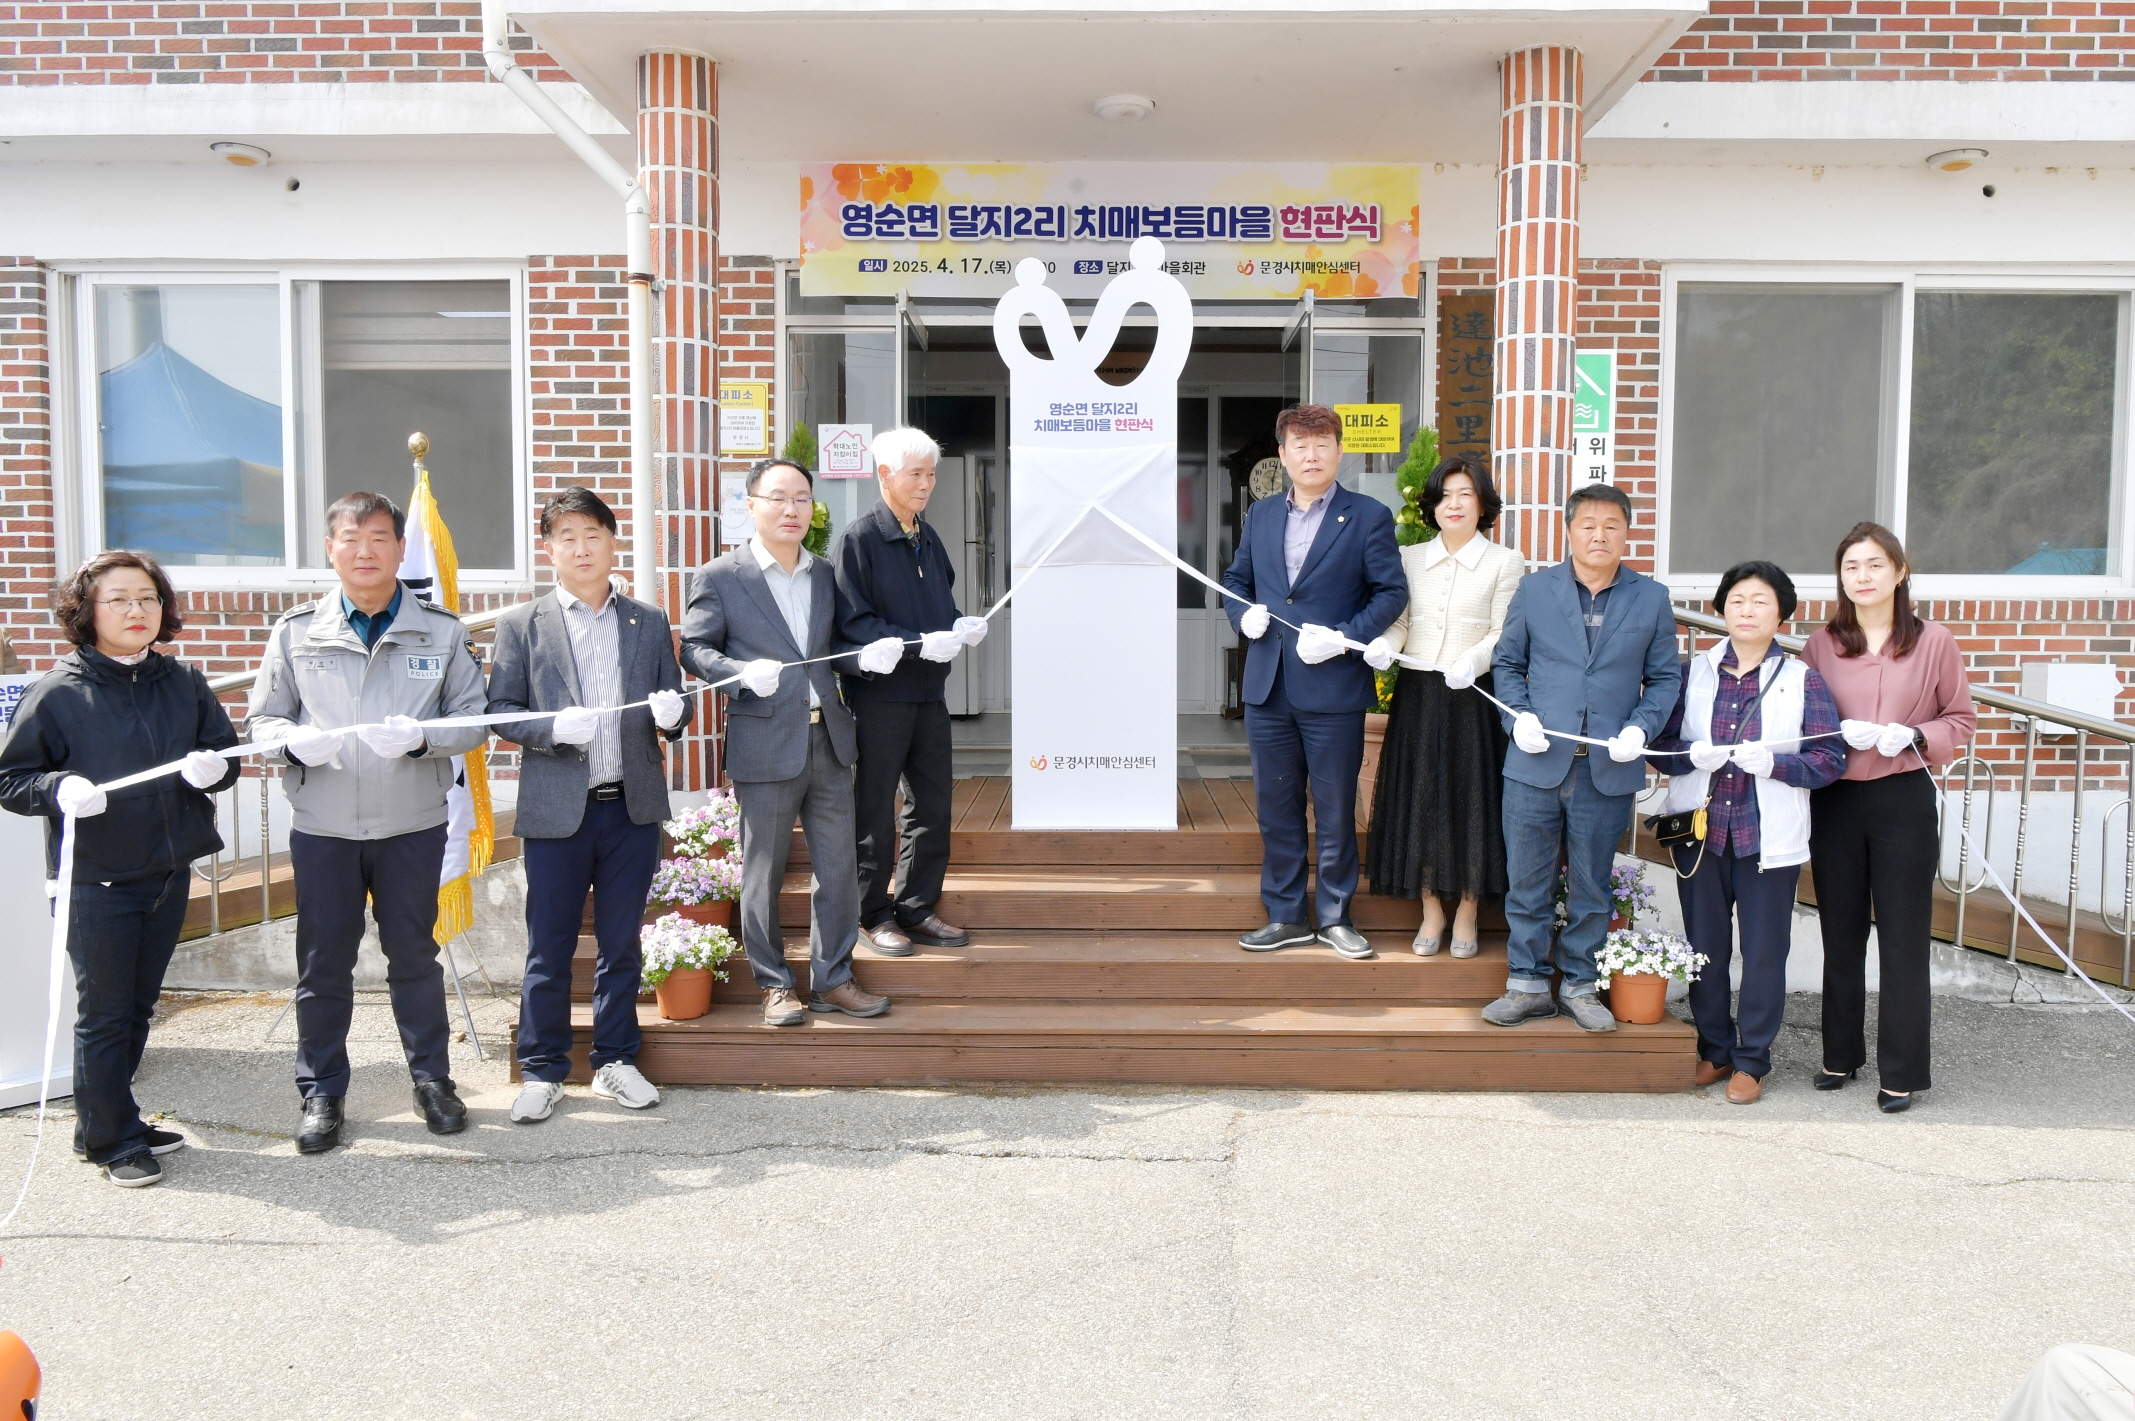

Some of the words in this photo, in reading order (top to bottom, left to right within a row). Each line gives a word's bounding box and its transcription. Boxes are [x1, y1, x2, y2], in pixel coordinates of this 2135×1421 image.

[842, 203, 939, 238] 영순면
[949, 204, 1065, 239] 달지2리
[1073, 205, 1272, 239] 치매보듬마을
[1279, 205, 1378, 239] 현판식
[863, 260, 884, 272] 일시
[892, 260, 933, 274] 2025.
[936, 258, 954, 274] 4.
[1078, 261, 1100, 273] 장소
[1259, 261, 1361, 275] 문경시치매안심센터
[720, 390, 753, 400] 대피소
[1049, 402, 1088, 416] 영순면
[1091, 402, 1138, 416] 달지2리
[1034, 418, 1112, 432] 치매보듬마을
[1114, 418, 1154, 432] 현판식
[1345, 414, 1389, 428] 대피소
[833, 442, 858, 450] 학대노인
[409, 658, 438, 670] 경찰
[1053, 755, 1157, 770] 문경시치매안심센터
